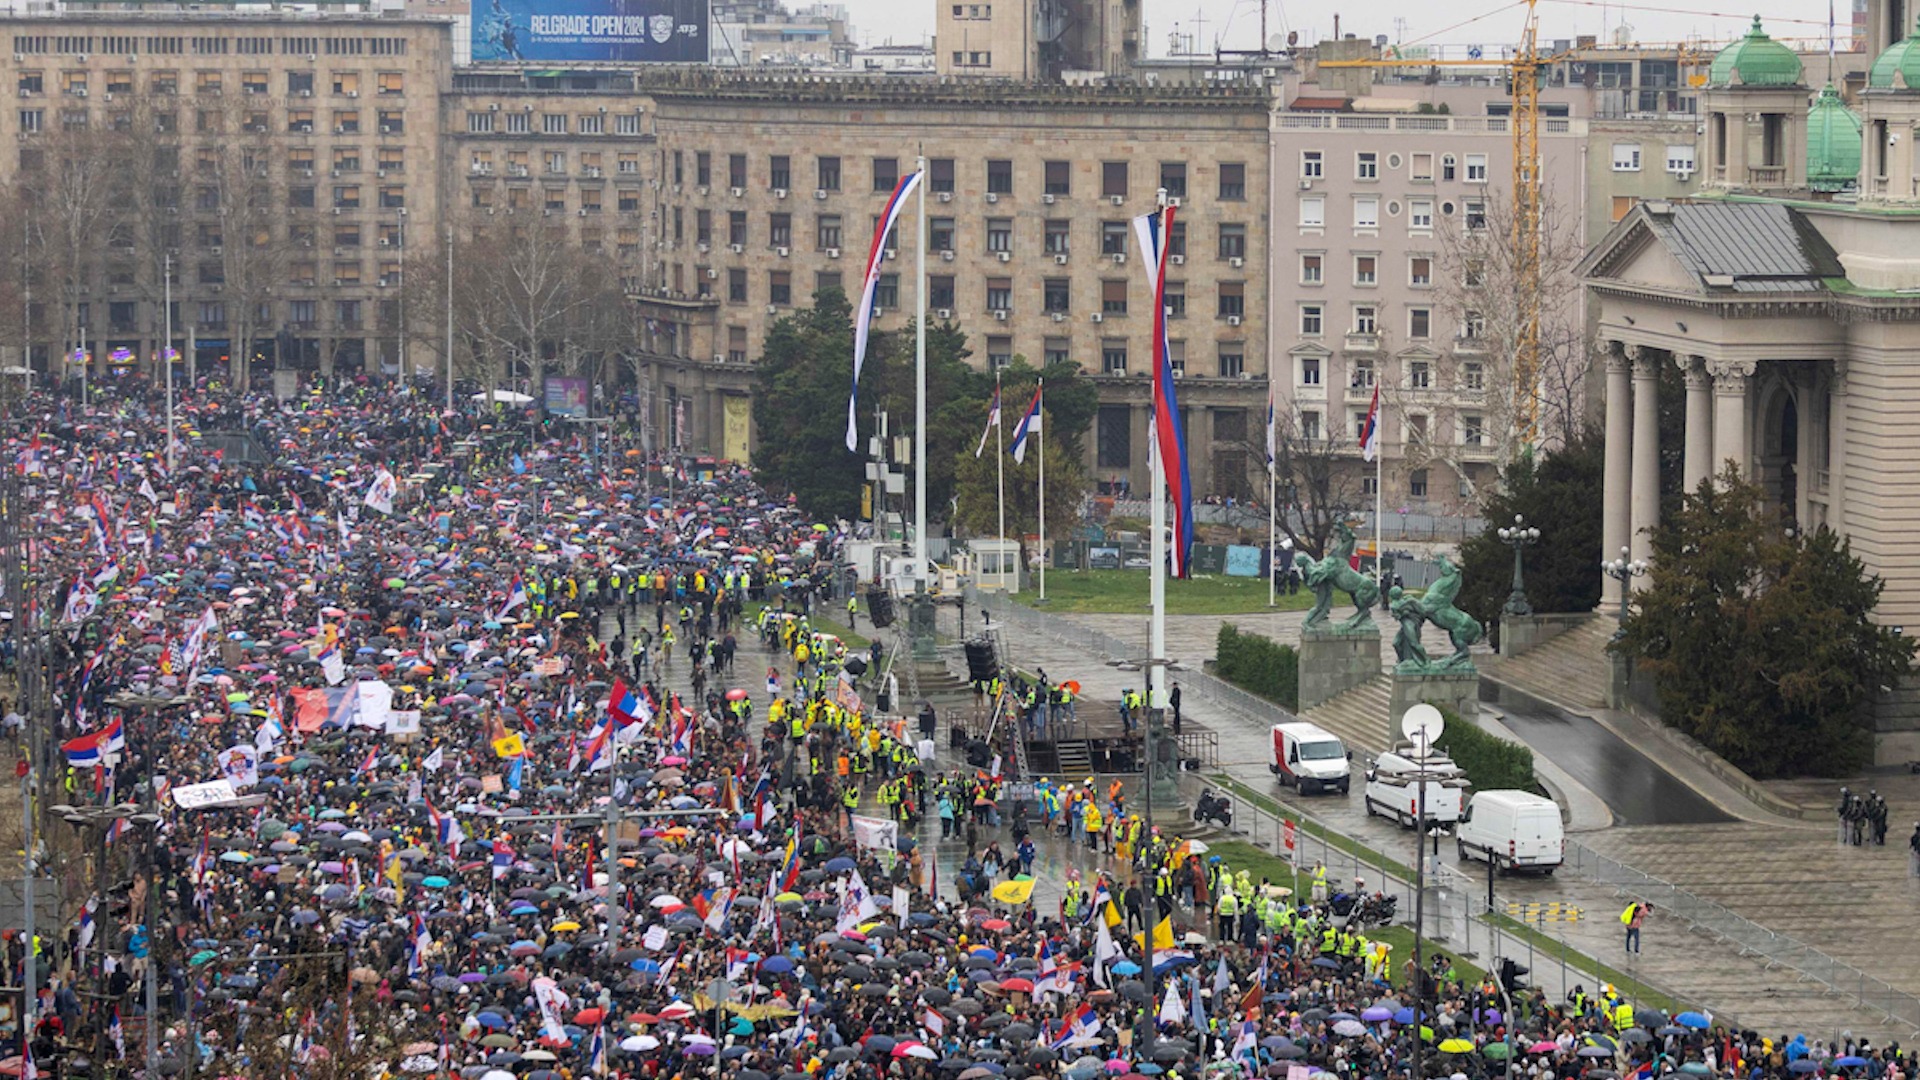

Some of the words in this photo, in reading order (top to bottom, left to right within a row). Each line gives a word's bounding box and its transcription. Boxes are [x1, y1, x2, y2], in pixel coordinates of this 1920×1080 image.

[531, 15, 590, 35] BELGRADE
[591, 15, 624, 35] OPEN
[624, 16, 645, 35] 2024
[677, 24, 698, 33] ATP
